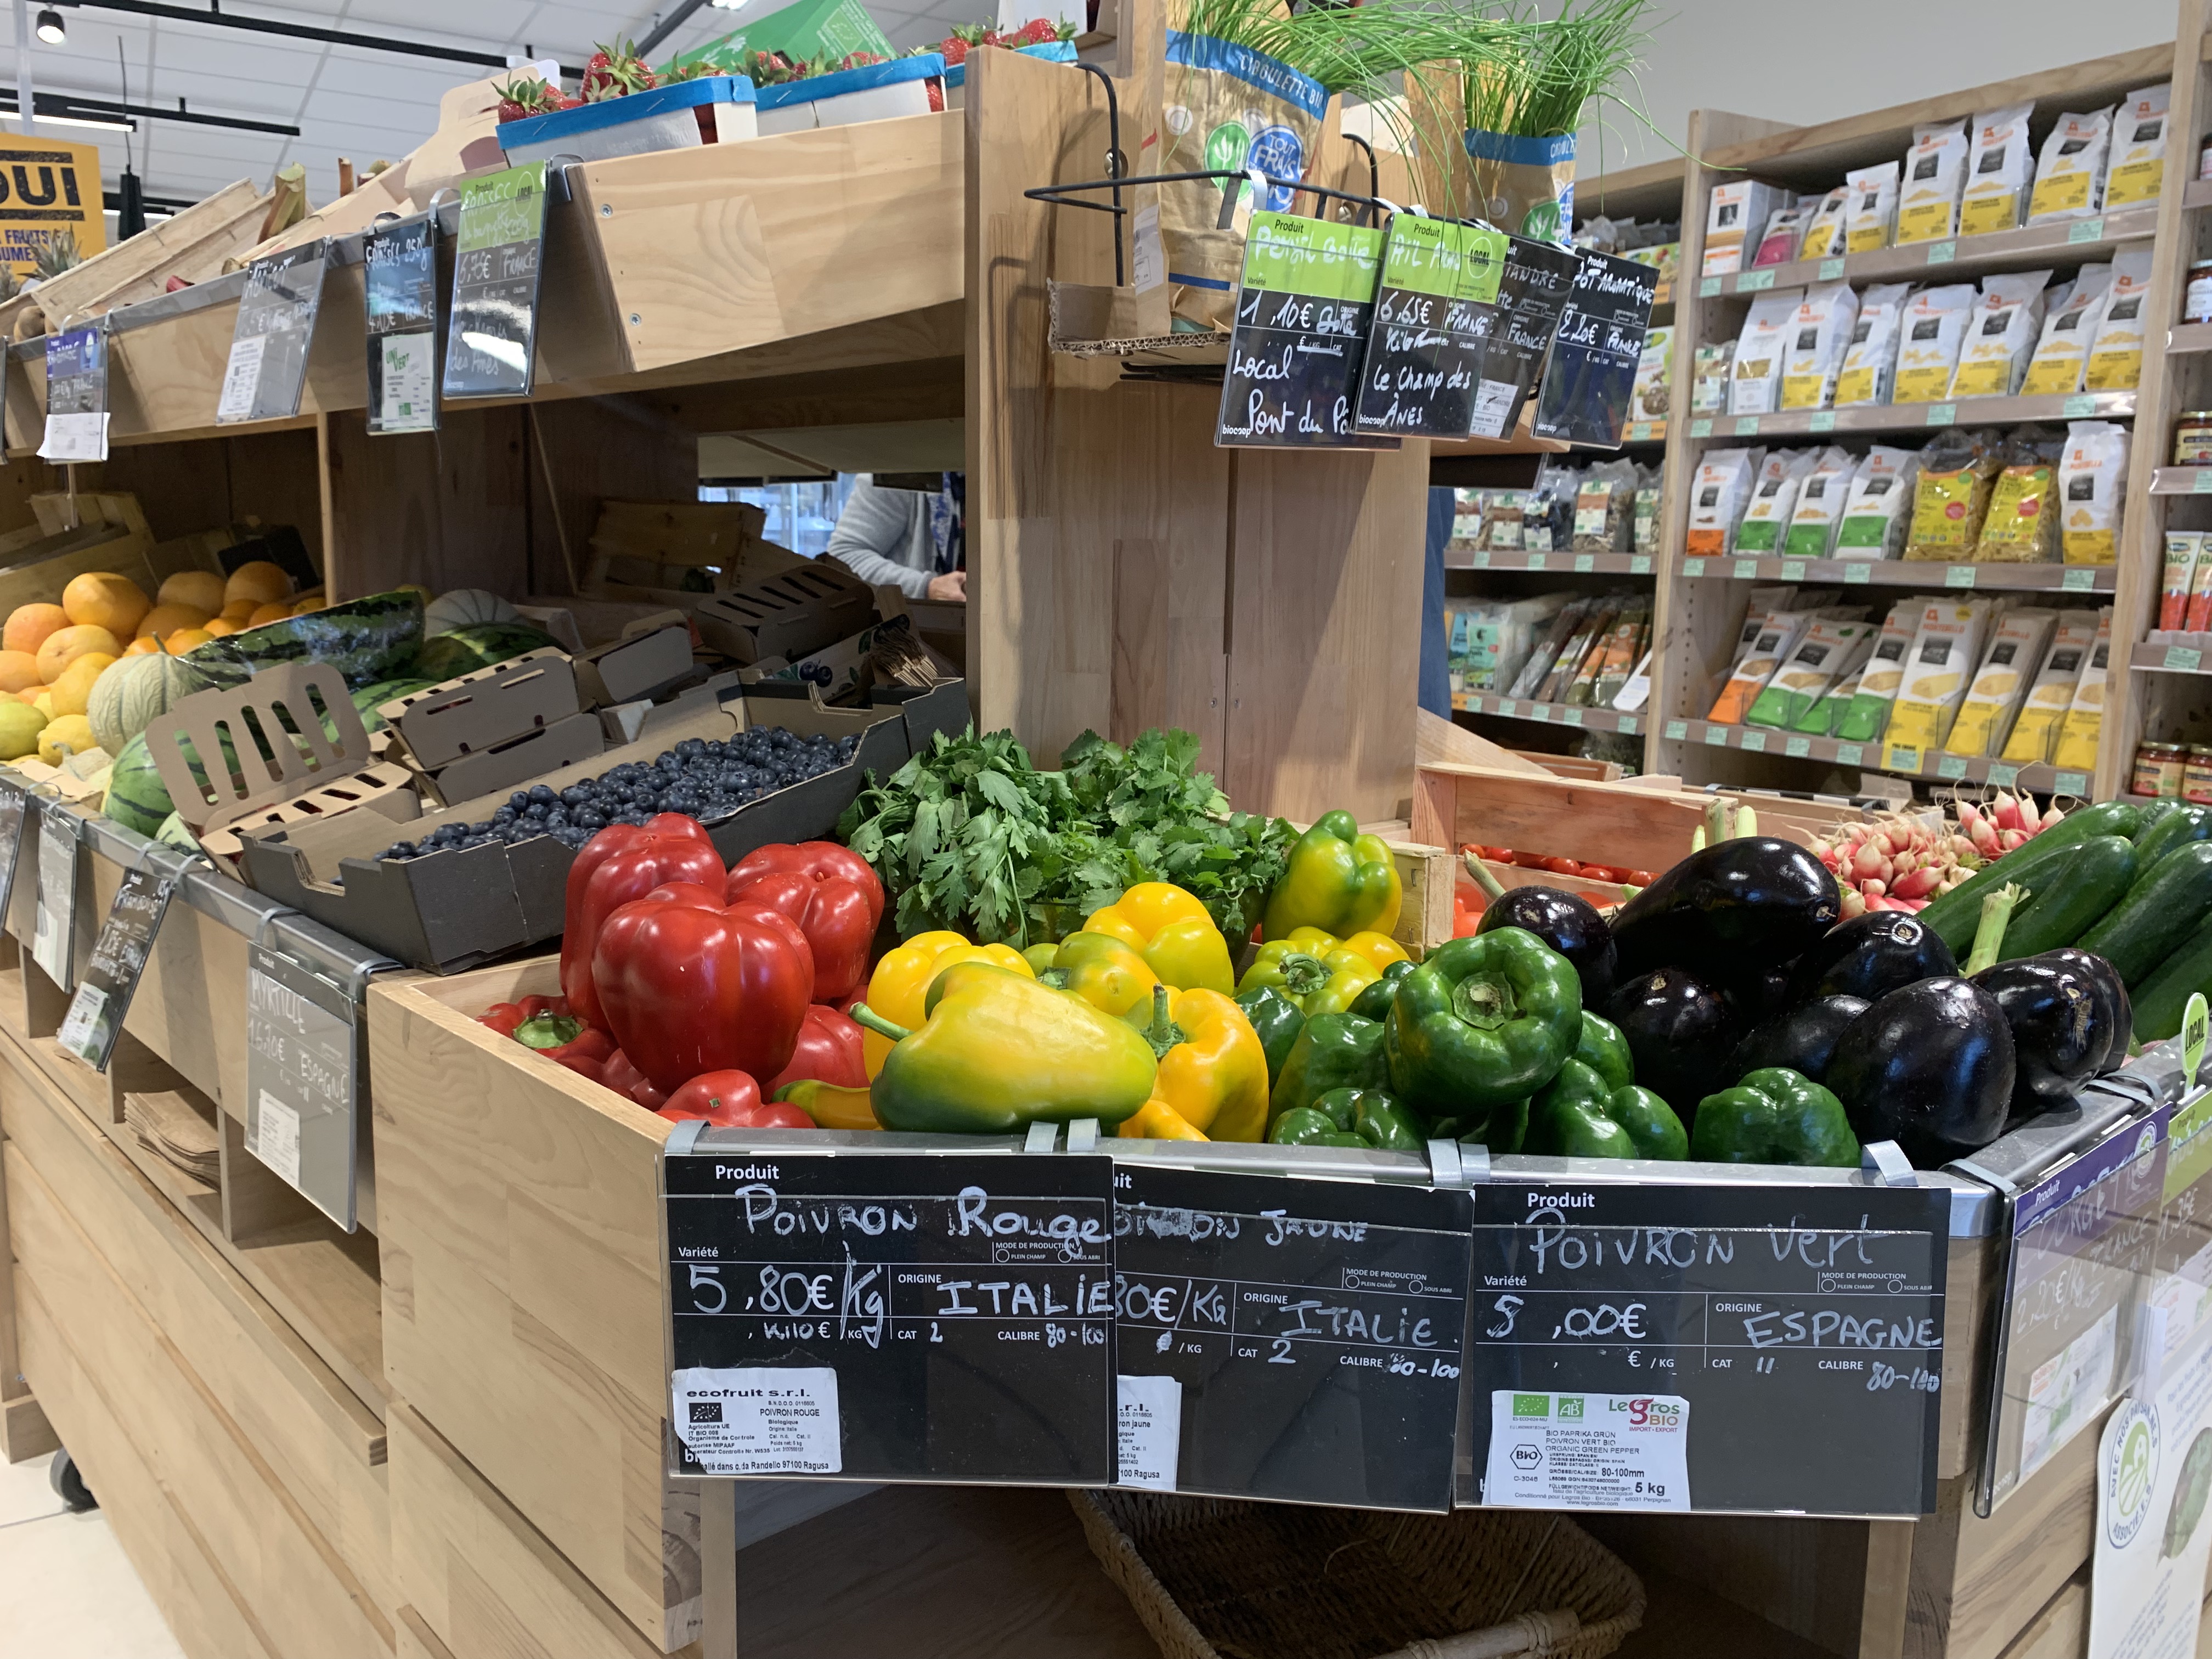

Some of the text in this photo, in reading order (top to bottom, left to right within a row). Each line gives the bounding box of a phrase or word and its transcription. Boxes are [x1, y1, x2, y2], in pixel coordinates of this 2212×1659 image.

[1240, 53, 1307, 99] CIBOULETTE
[1269, 135, 1296, 156] TOUT
[1254, 144, 1295, 180] FRAIS
[0, 166, 81, 206] UI
[1274, 219, 1305, 233] Produit
[1414, 223, 1440, 238] Produit
[1470, 249, 1490, 266] LOCAL
[1587, 255, 1608, 269] Produit
[1248, 276, 1266, 286] Variété
[1387, 275, 1404, 285] Variété
[1505, 261, 1559, 289] IANDRE
[1340, 306, 1359, 314] ORIGINE
[1507, 323, 1547, 351] FRANCE
[1459, 342, 1475, 350] CALIBRE
[1398, 360, 1471, 401] Champ des
[1299, 399, 1323, 433] du
[1222, 424, 1251, 438] biocoop
[2166, 554, 2190, 564] BIO
[2186, 1015, 2204, 1052] LOCAL
[715, 1164, 780, 1180] Produit
[1527, 1192, 1595, 1207] Produit
[2035, 1180, 2060, 1206] Produit
[957, 1186, 1112, 1258] Rouge
[678, 1246, 719, 1258] Variété
[1029, 1242, 1075, 1250] PRODUCTION
[898, 1274, 942, 1284] ORIGINE
[1346, 1268, 1368, 1277] MODE
[1380, 1271, 1427, 1281] PRODUCTION
[1484, 1276, 1527, 1286] Variété
[1244, 1292, 1288, 1304] ORIGINE
[1716, 1303, 1762, 1312] ORIGINE
[898, 1321, 943, 1343] CAT 2
[997, 1330, 1040, 1341] CALIBRE
[1743, 1310, 1943, 1350] ESPAGNE
[1238, 1348, 1258, 1358] CAT
[1268, 1339, 1296, 1363] 2
[1340, 1356, 1383, 1368] CALIBRE
[1627, 1350, 1641, 1368] €
[1712, 1359, 1733, 1368] CAT
[1818, 1361, 1864, 1370] CALIBRE
[686, 1389, 763, 1397] ecofruit
[760, 1408, 792, 1417] POIVRON
[1132, 1420, 1151, 1429] jaune
[1649, 1414, 1679, 1426] BIO
[2117, 1417, 2129, 1449] NOS
[716, 1462, 733, 1471] dans
[751, 1461, 781, 1470] Randello
[782, 1460, 802, 1469] 97100
[804, 1461, 829, 1471] Ragusa
[1601, 1467, 1645, 1477] 80-100mm
[1133, 1469, 1160, 1480] Ragusa
[1635, 1482, 1643, 1493] 5
[1647, 1482, 1666, 1497] kg
